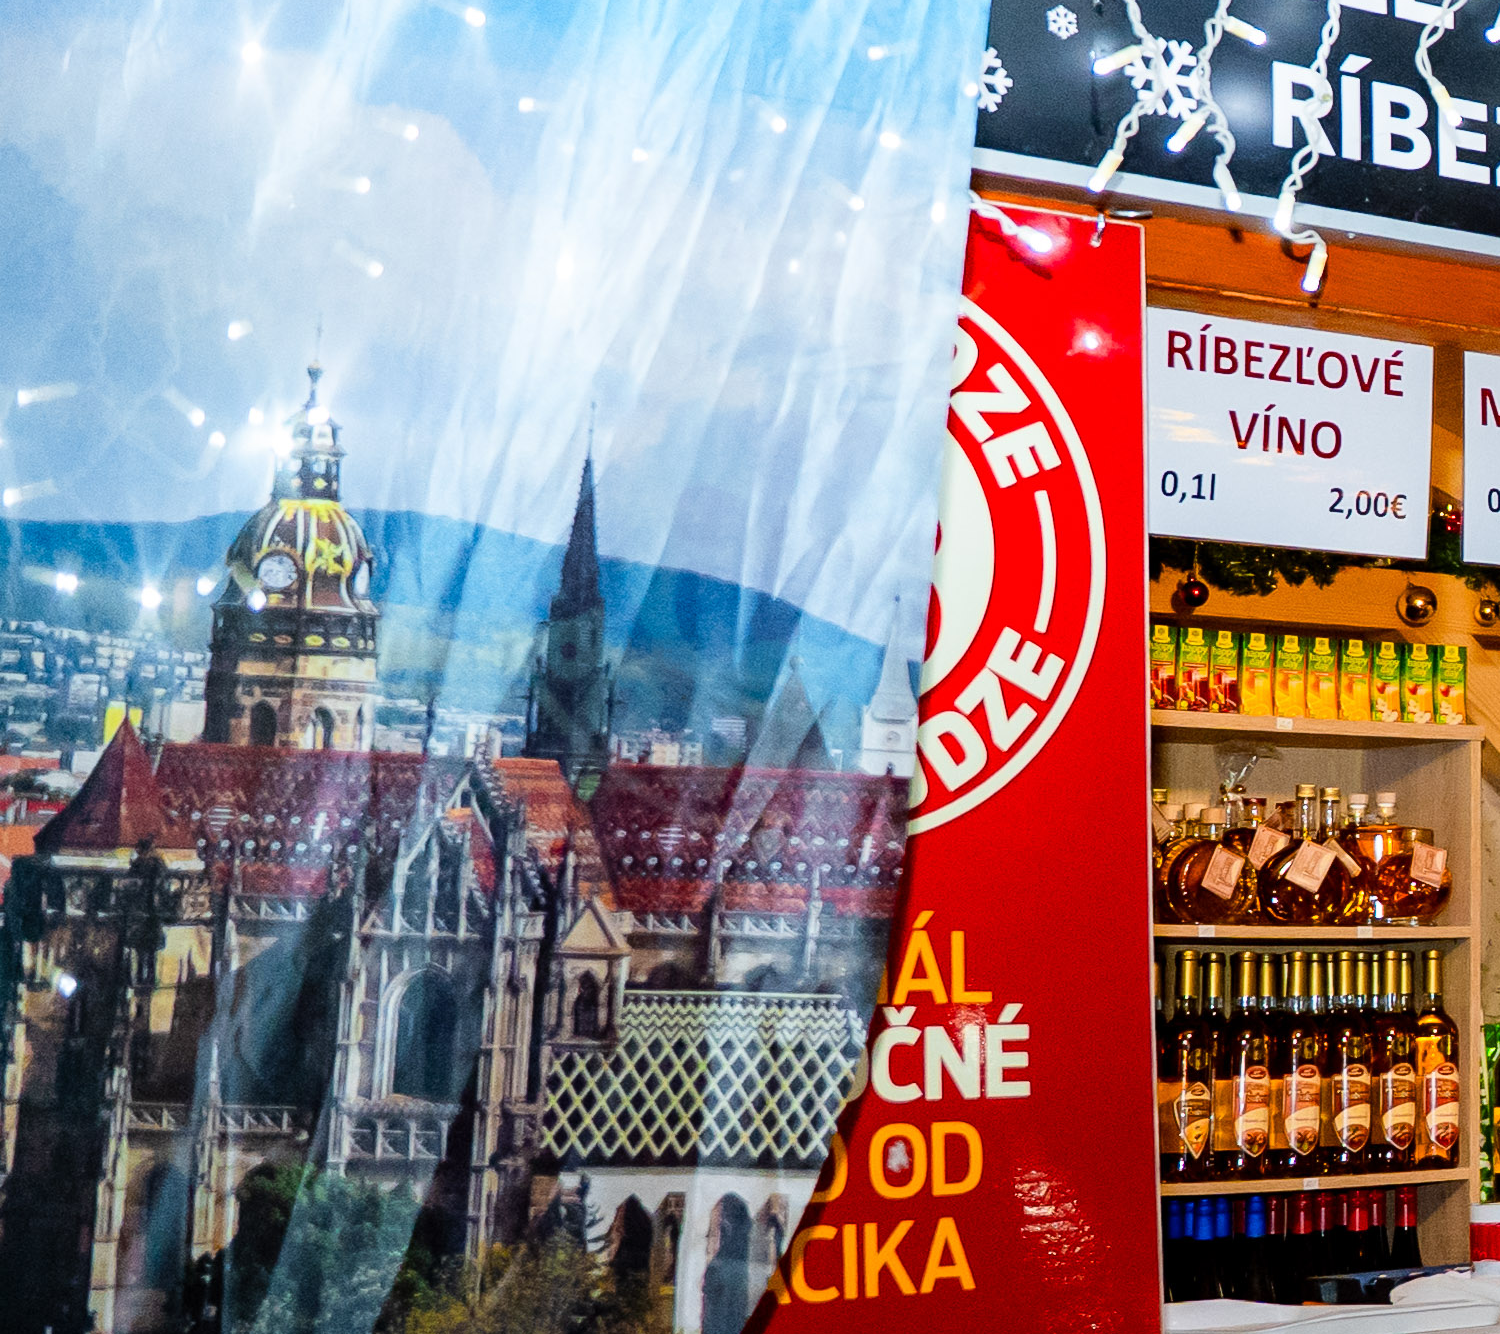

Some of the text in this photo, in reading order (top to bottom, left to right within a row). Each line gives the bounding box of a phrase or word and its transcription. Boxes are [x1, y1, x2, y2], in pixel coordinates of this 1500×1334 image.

[1166, 323, 1404, 397] RÍBEZĽOVÉ
[1228, 404, 1342, 460] VÍNO
[1329, 486, 1408, 522] 2,00€
[877, 910, 993, 1005] ÁL
[869, 1121, 983, 1201] OD
